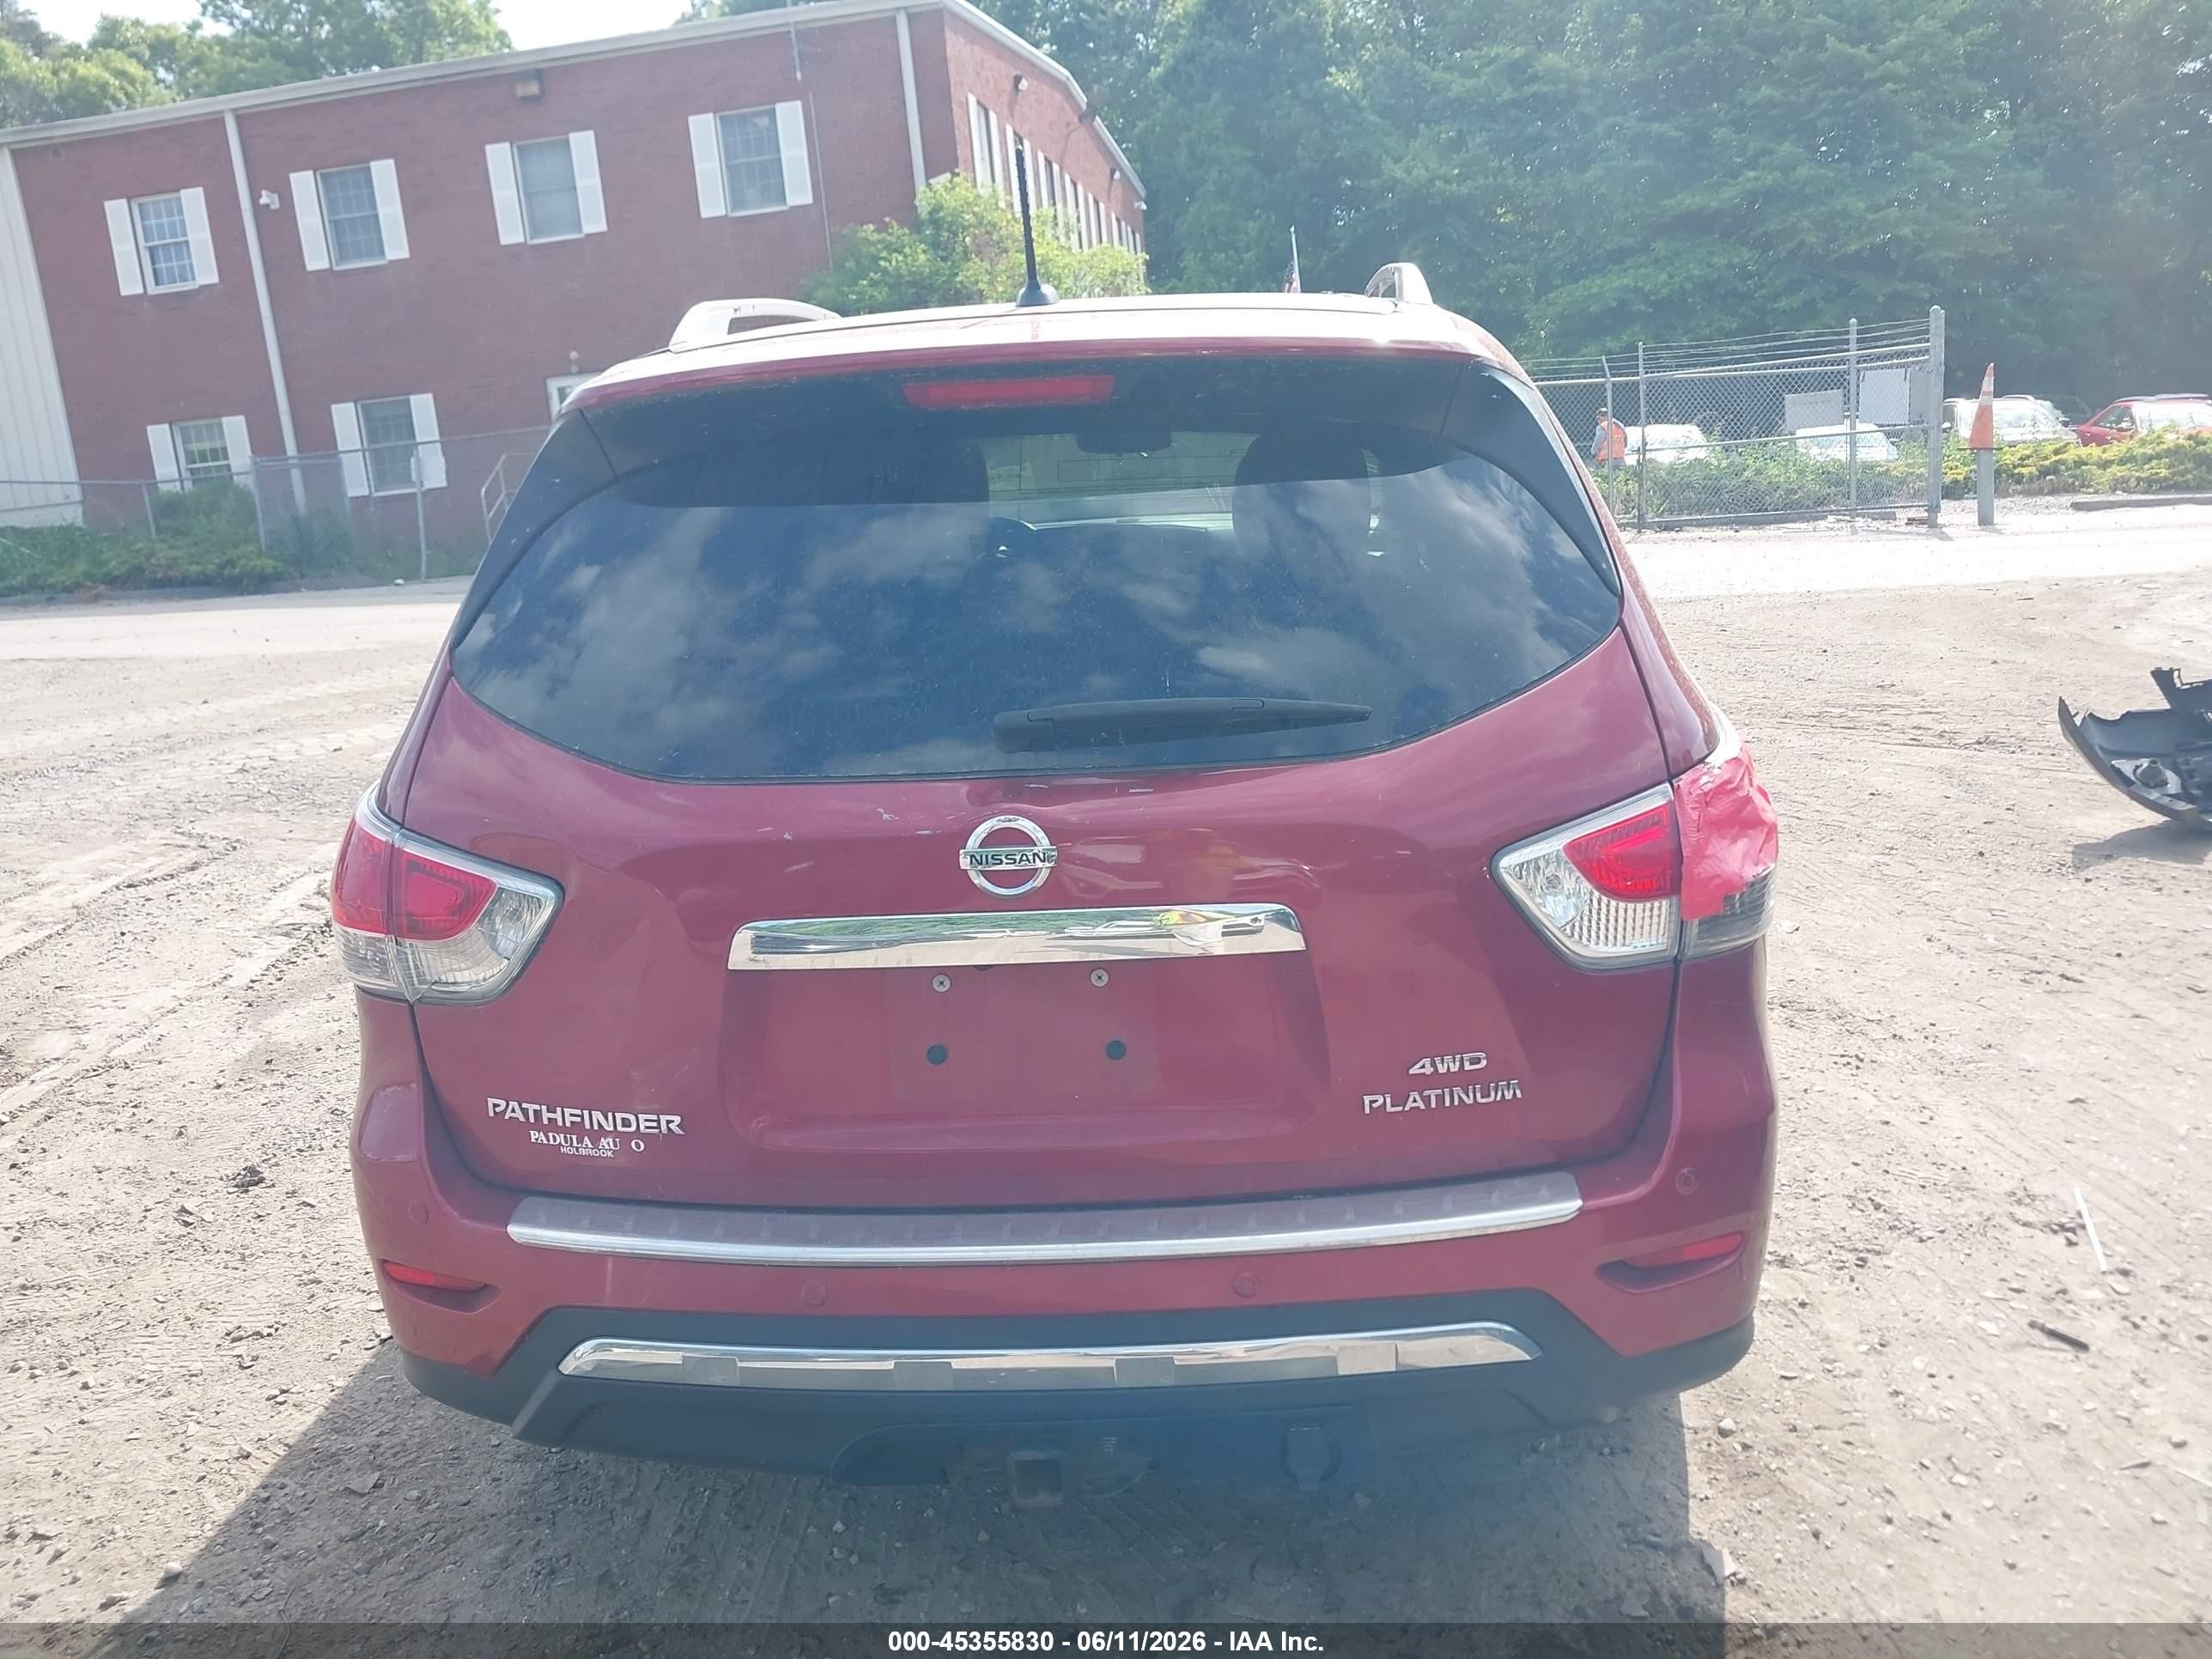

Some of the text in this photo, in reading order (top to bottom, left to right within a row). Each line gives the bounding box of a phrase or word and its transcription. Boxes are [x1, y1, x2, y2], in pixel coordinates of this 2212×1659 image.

[969, 851, 1047, 866] NISSAN
[1408, 1051, 1488, 1075] 4WD
[1362, 1079, 1522, 1115] PLATINUM
[487, 1097, 686, 1135] PATHFINDER
[529, 1130, 594, 1149] PADULA
[560, 1146, 614, 1158] HOLBROOK
